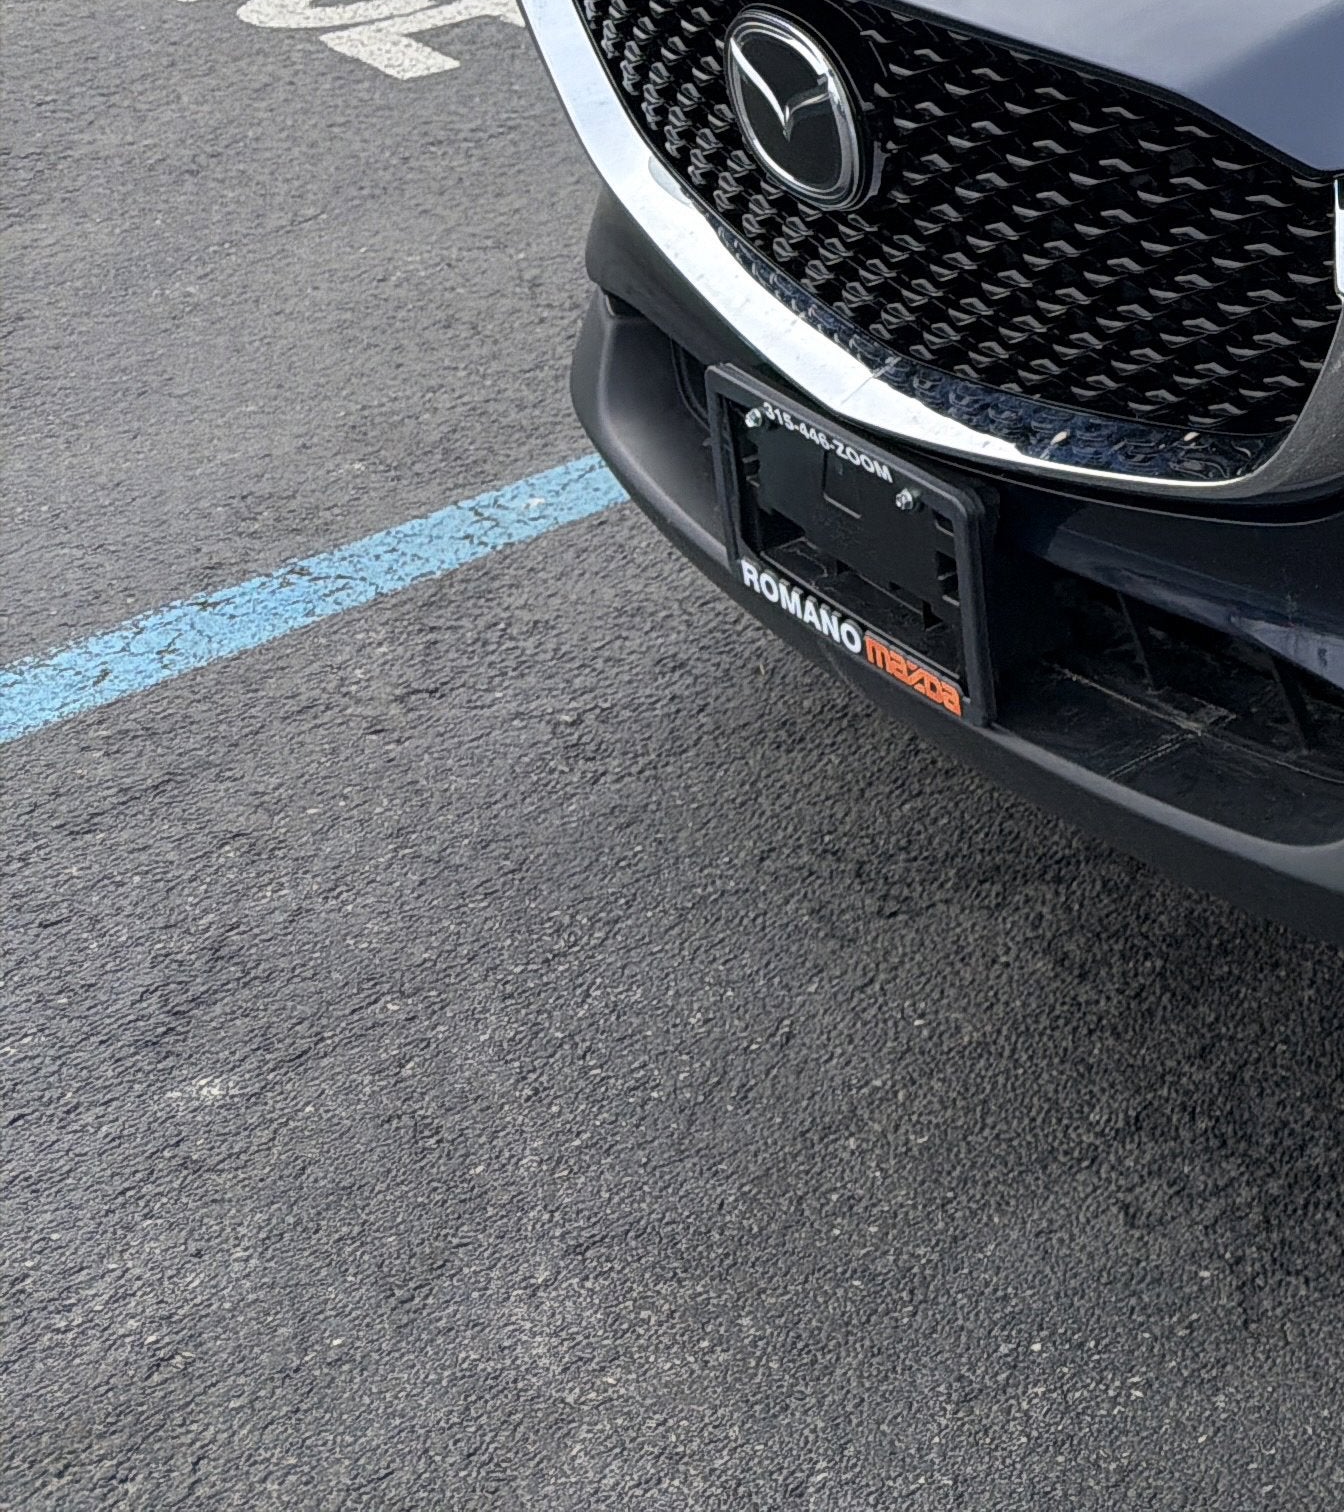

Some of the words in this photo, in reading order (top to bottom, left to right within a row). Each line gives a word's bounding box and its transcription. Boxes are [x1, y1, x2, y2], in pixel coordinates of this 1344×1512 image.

[763, 401, 894, 483] 315-446-ZOOM
[740, 559, 862, 654] ROMANO
[864, 629, 963, 717] mazda
